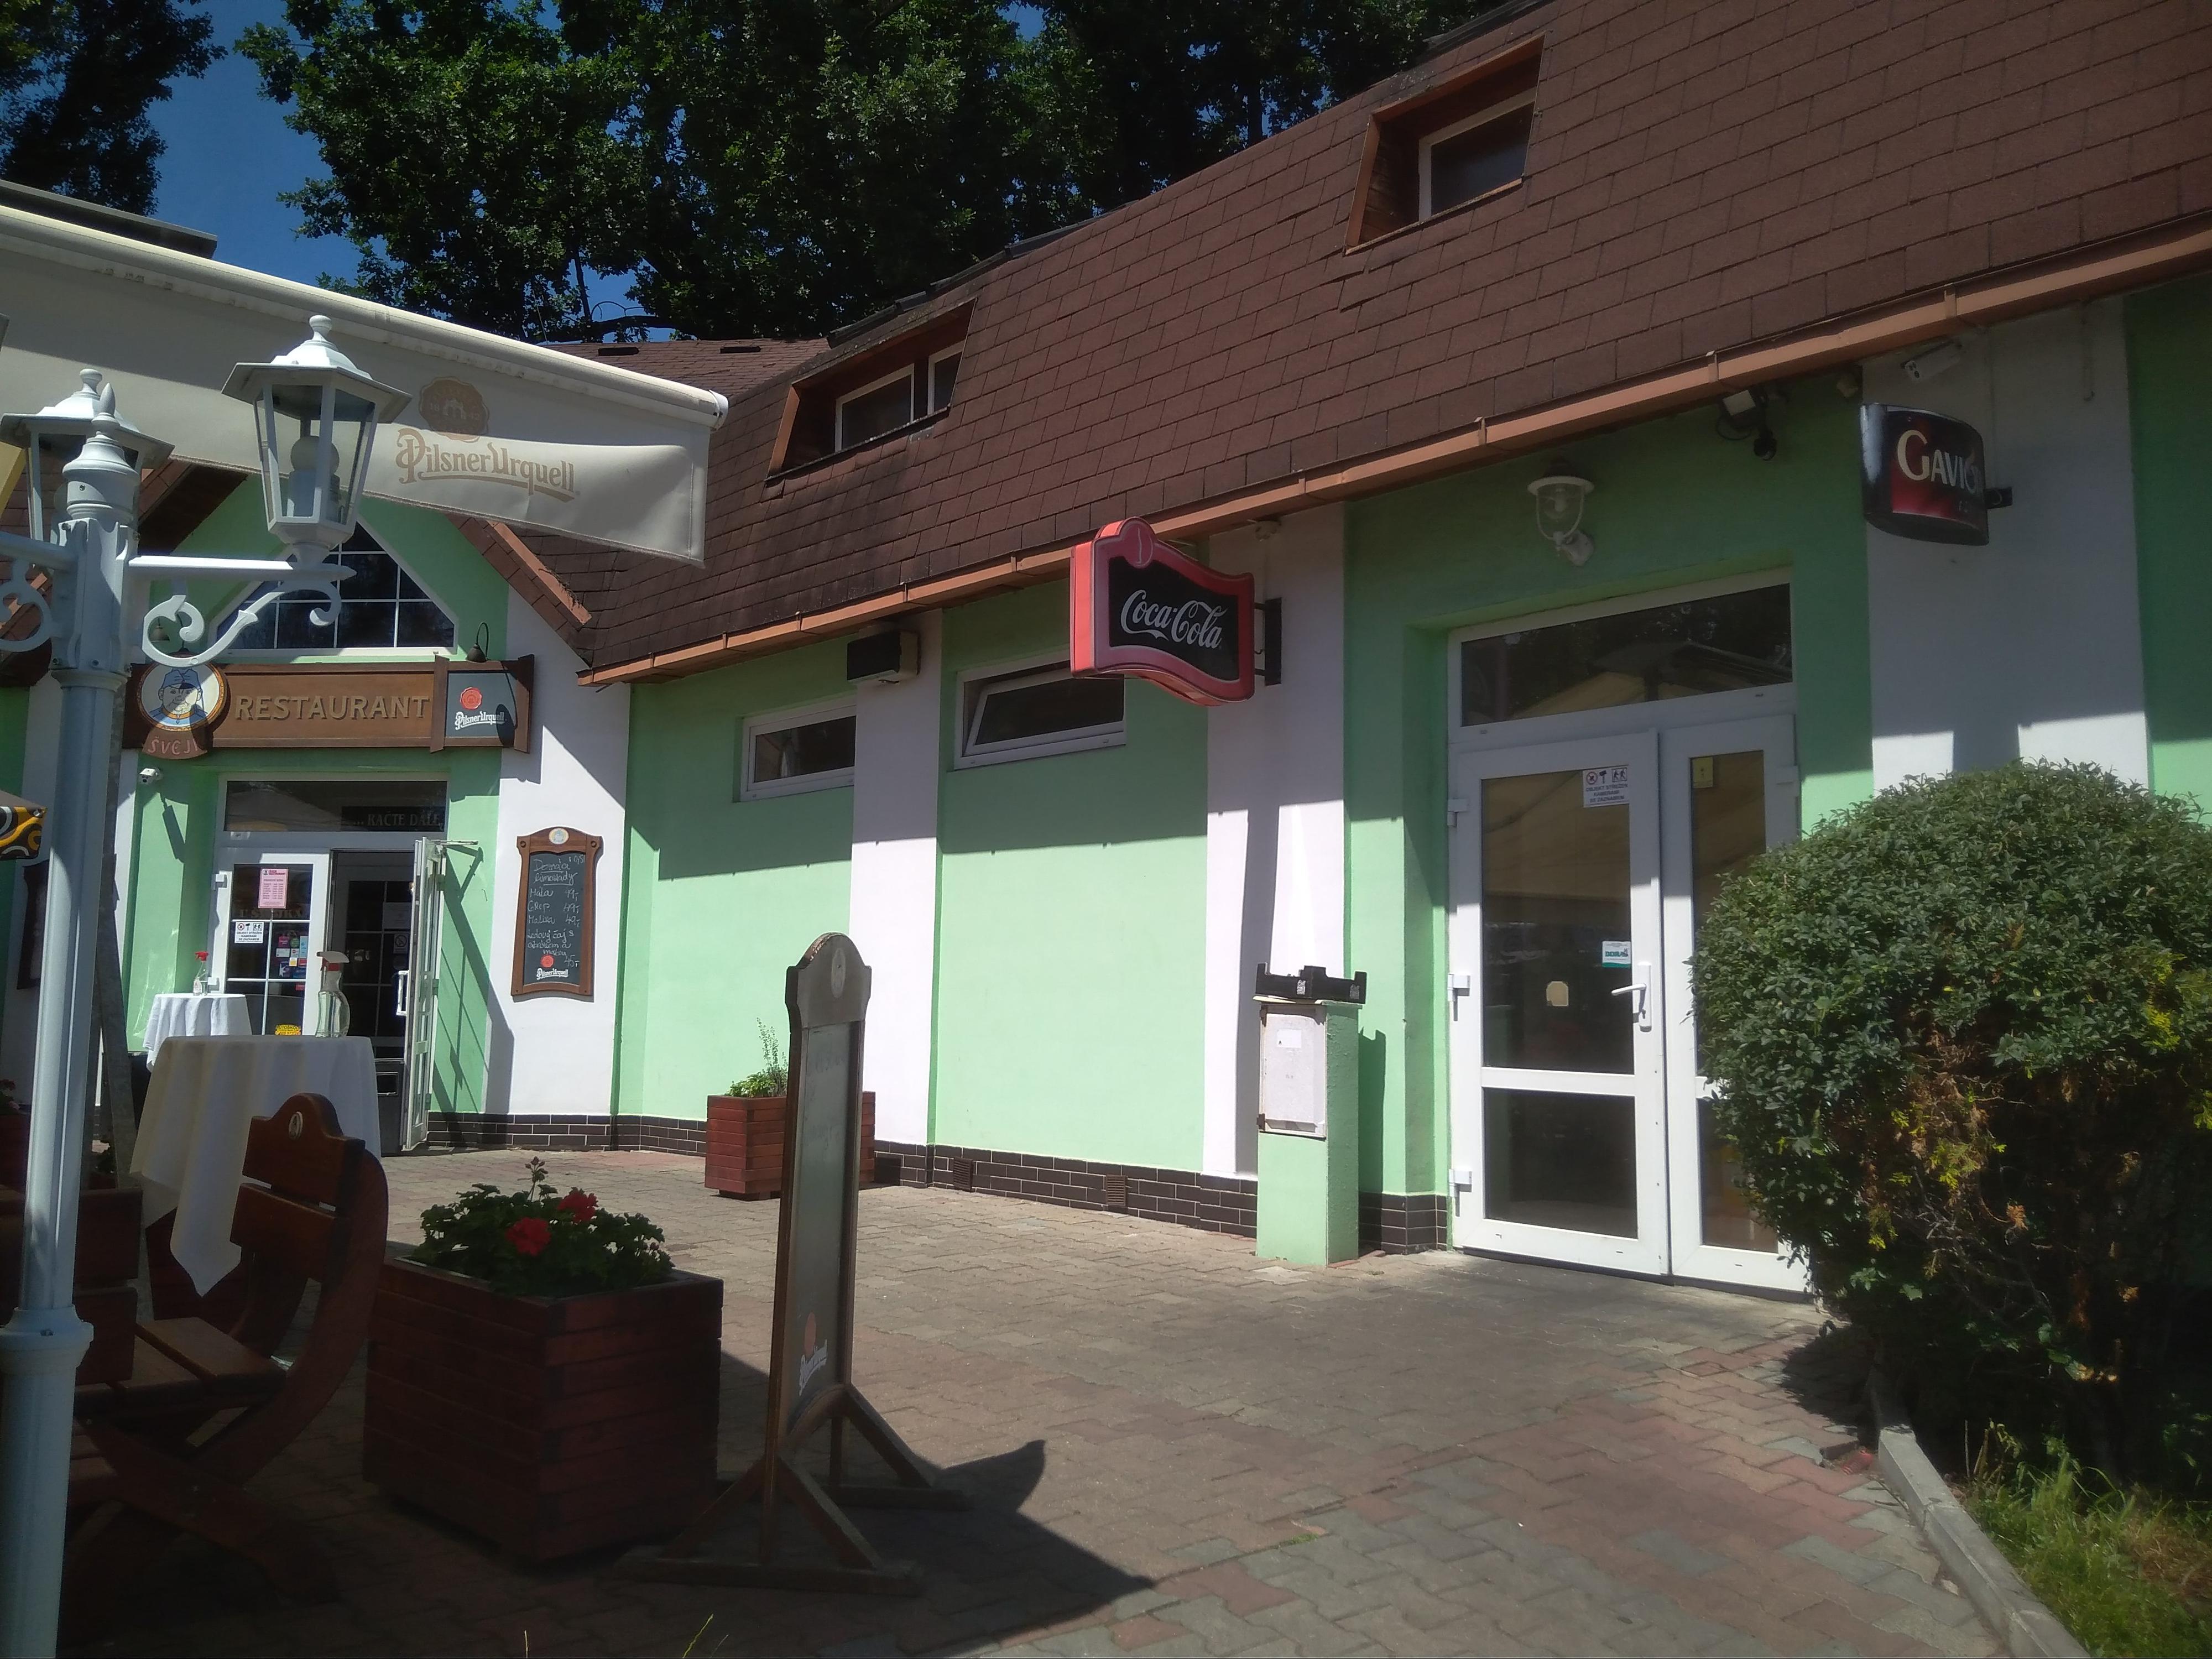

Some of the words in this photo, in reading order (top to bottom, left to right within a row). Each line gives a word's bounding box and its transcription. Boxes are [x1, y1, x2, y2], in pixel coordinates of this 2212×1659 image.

[395, 429, 491, 484] Pilsner
[487, 442, 575, 496] Urquell
[1120, 589, 1229, 649] Coca-Cola
[234, 695, 431, 721] RESTAURANT
[455, 711, 481, 730] Pilsner
[479, 711, 504, 725] Urquell
